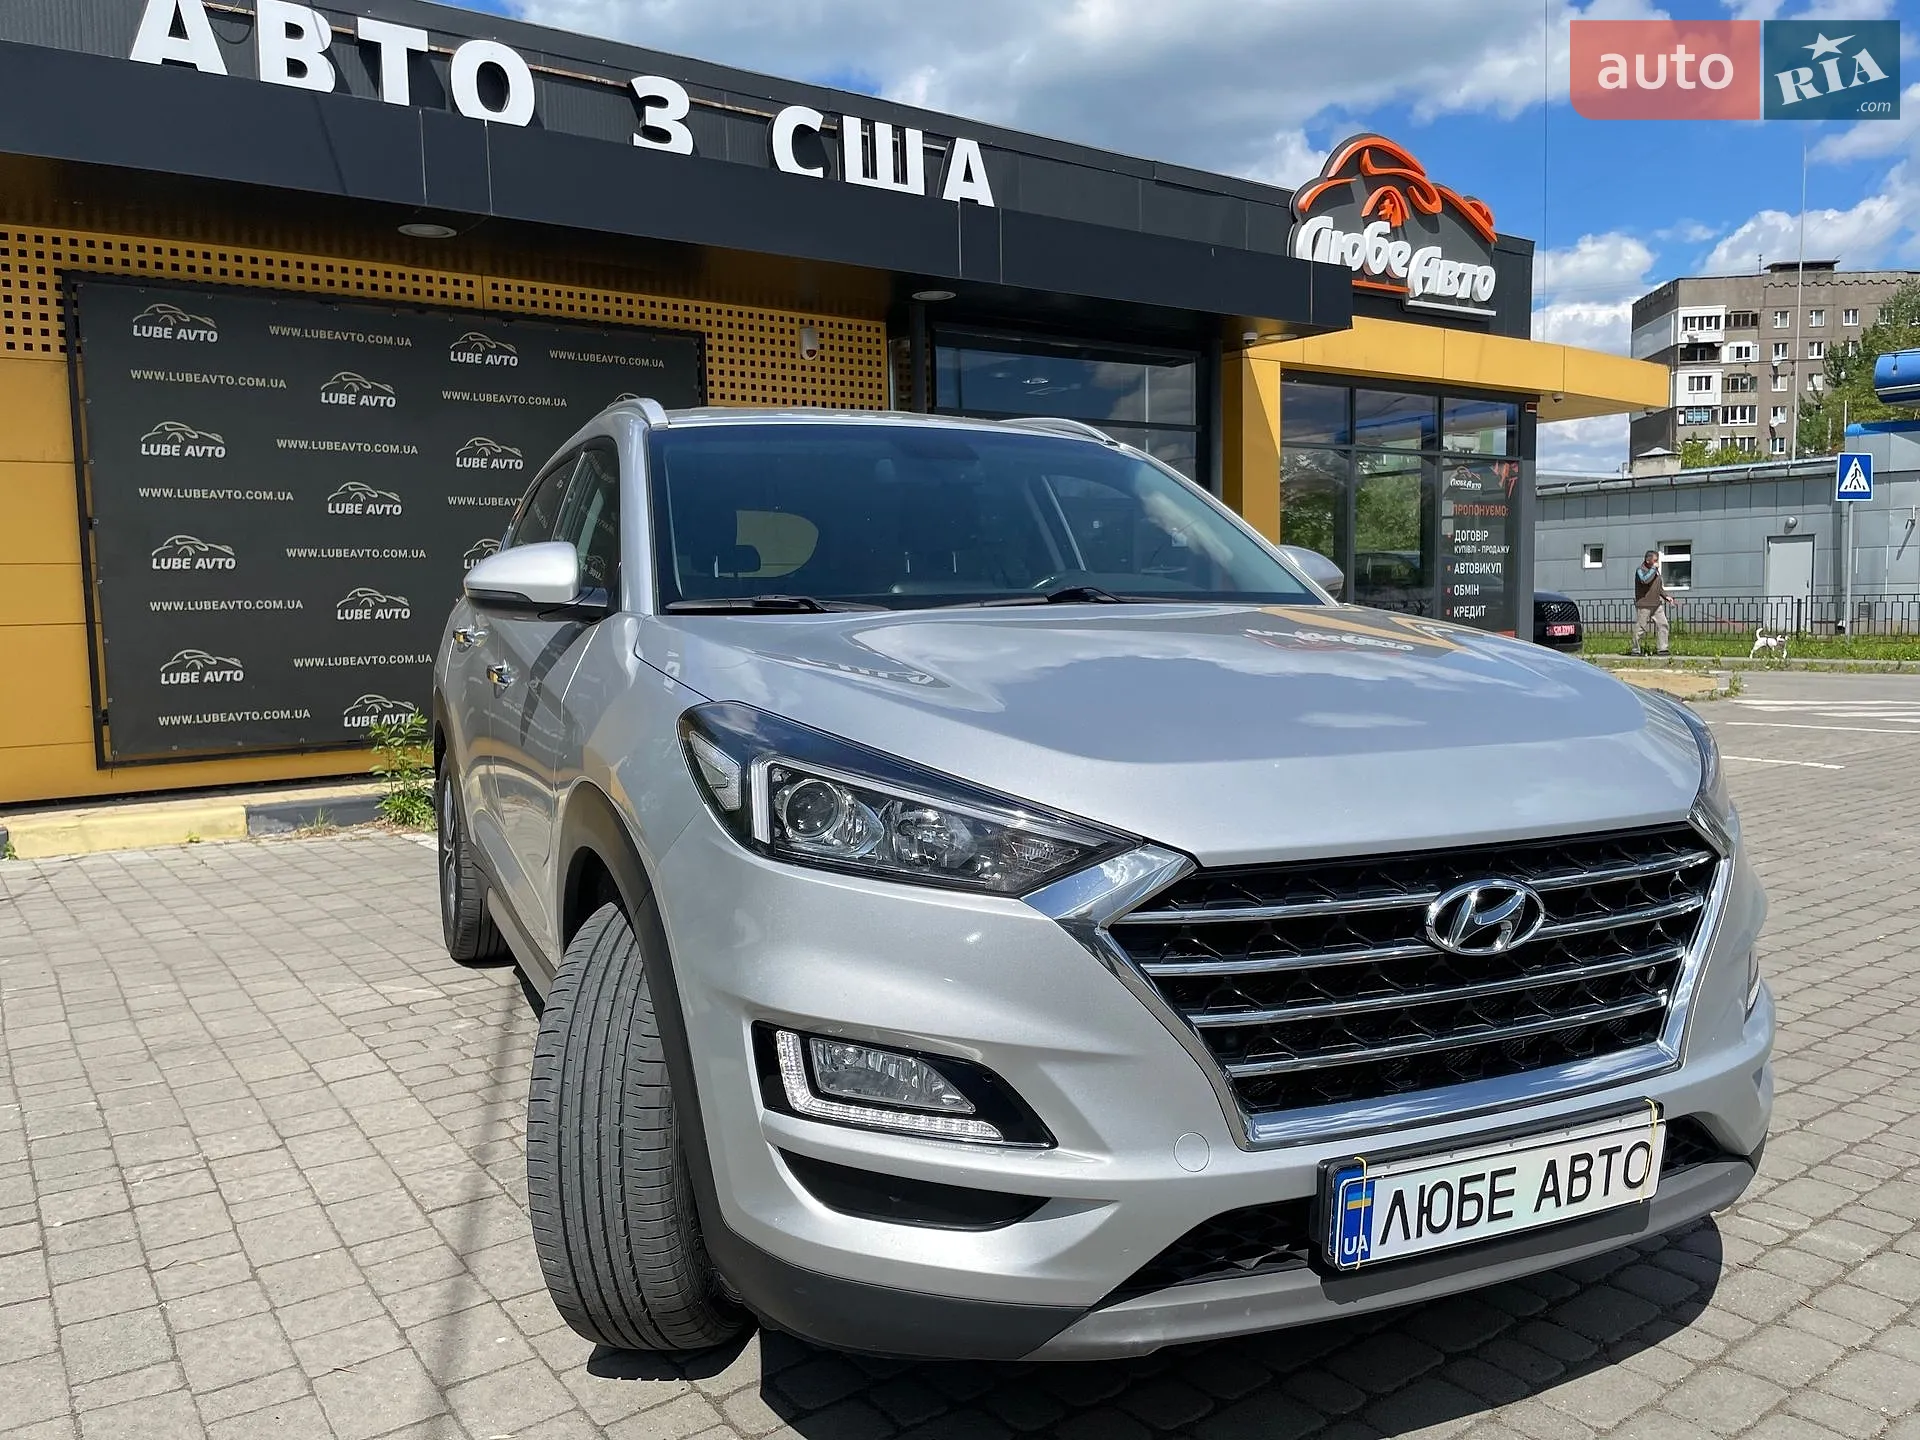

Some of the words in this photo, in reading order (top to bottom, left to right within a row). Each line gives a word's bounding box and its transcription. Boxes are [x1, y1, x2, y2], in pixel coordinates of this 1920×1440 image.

[130, 0, 536, 127] АВТО
[771, 105, 995, 207] США
[132, 324, 173, 340] LUBE
[176, 326, 219, 343] AVTO
[268, 325, 413, 348] WWW.LUBEAVTO.COM.UA
[450, 350, 482, 364] LUBE
[485, 352, 519, 367] AVTO
[549, 349, 665, 369] WWW.LUBEAVTO.COM.UA
[130, 369, 287, 389] WWW.LUBEAVTO.COM.UA
[320, 392, 356, 405] LUBE
[359, 394, 397, 408] AVTO
[441, 390, 568, 408] WWW.LUBEAVTO.COM.UA
[141, 444, 180, 457] LUBE
[184, 446, 226, 458] AVTO
[276, 439, 419, 455] WWW.LUBEAVTO.COM.UA
[456, 457, 488, 469] LUBE
[490, 458, 524, 470] AVTO
[138, 487, 294, 501] WWW.LUBEAVTO.COM.UA
[327, 502, 363, 515] LUBE
[366, 503, 402, 516] AVTO
[1454, 529, 1489, 543] ДОГОВІР
[286, 548, 427, 560] WWW.LUBEAVTO.COM.UA
[1481, 545, 1510, 554] ПРОДАЖУ
[152, 557, 192, 570] LUBE
[195, 557, 236, 570] AVTO
[1454, 562, 1502, 574] АВТОВИКУП
[1453, 584, 1480, 596] ОБМІН
[150, 599, 304, 612] WWW.LUBEAVTO.COM.UA
[1453, 605, 1487, 619] КРЕДИТ
[336, 608, 372, 620] LUBE
[375, 608, 411, 620] AVTO
[293, 654, 433, 668] WWW.LUBEAVTO.COM.UA
[160, 671, 200, 685] LUBE
[203, 669, 244, 684] AVTO
[158, 708, 311, 727] WWW.LUBEAVTO.COM.UA
[1379, 1166, 1517, 1246] ЛЮБЕ
[1533, 1140, 1652, 1213] АВТО
[1344, 1235, 1369, 1256] UA
